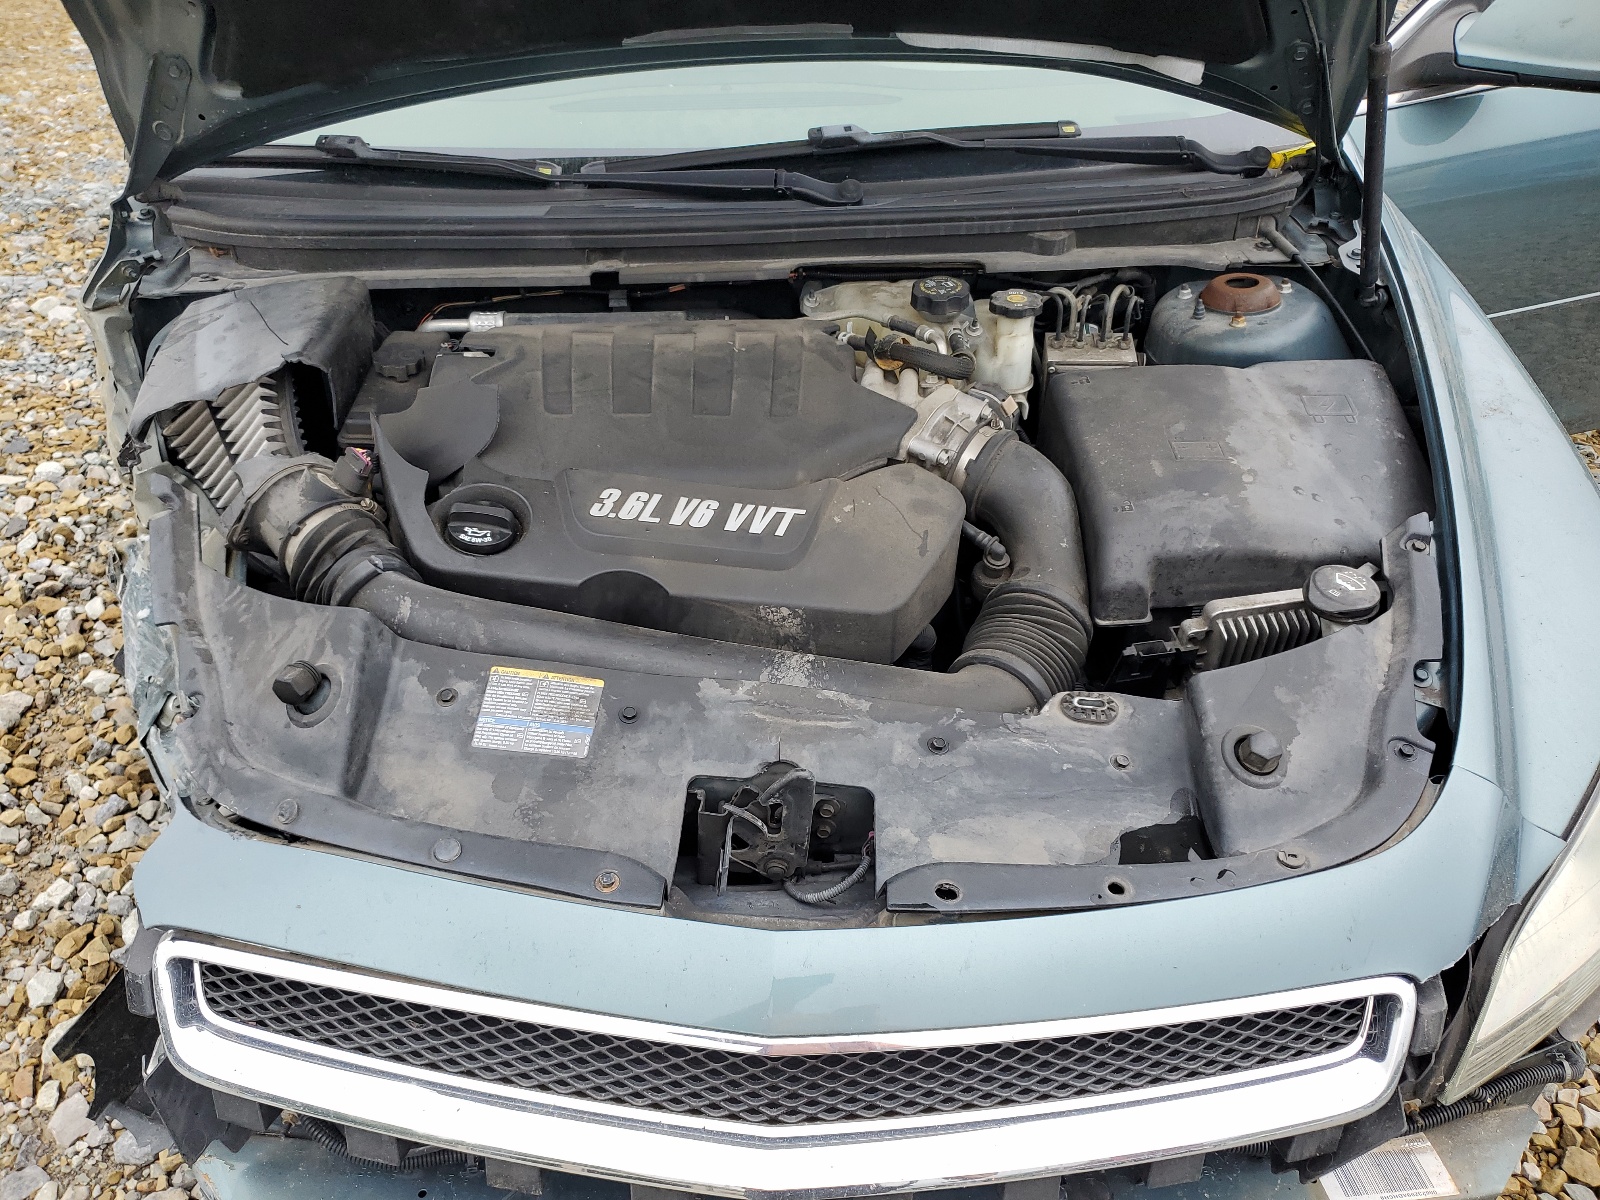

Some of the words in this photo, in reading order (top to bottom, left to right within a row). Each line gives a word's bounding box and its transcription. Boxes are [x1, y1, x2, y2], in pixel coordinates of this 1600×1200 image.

[589, 488, 663, 524] 3.6L
[668, 496, 720, 528] V6
[723, 502, 807, 537] VVT
